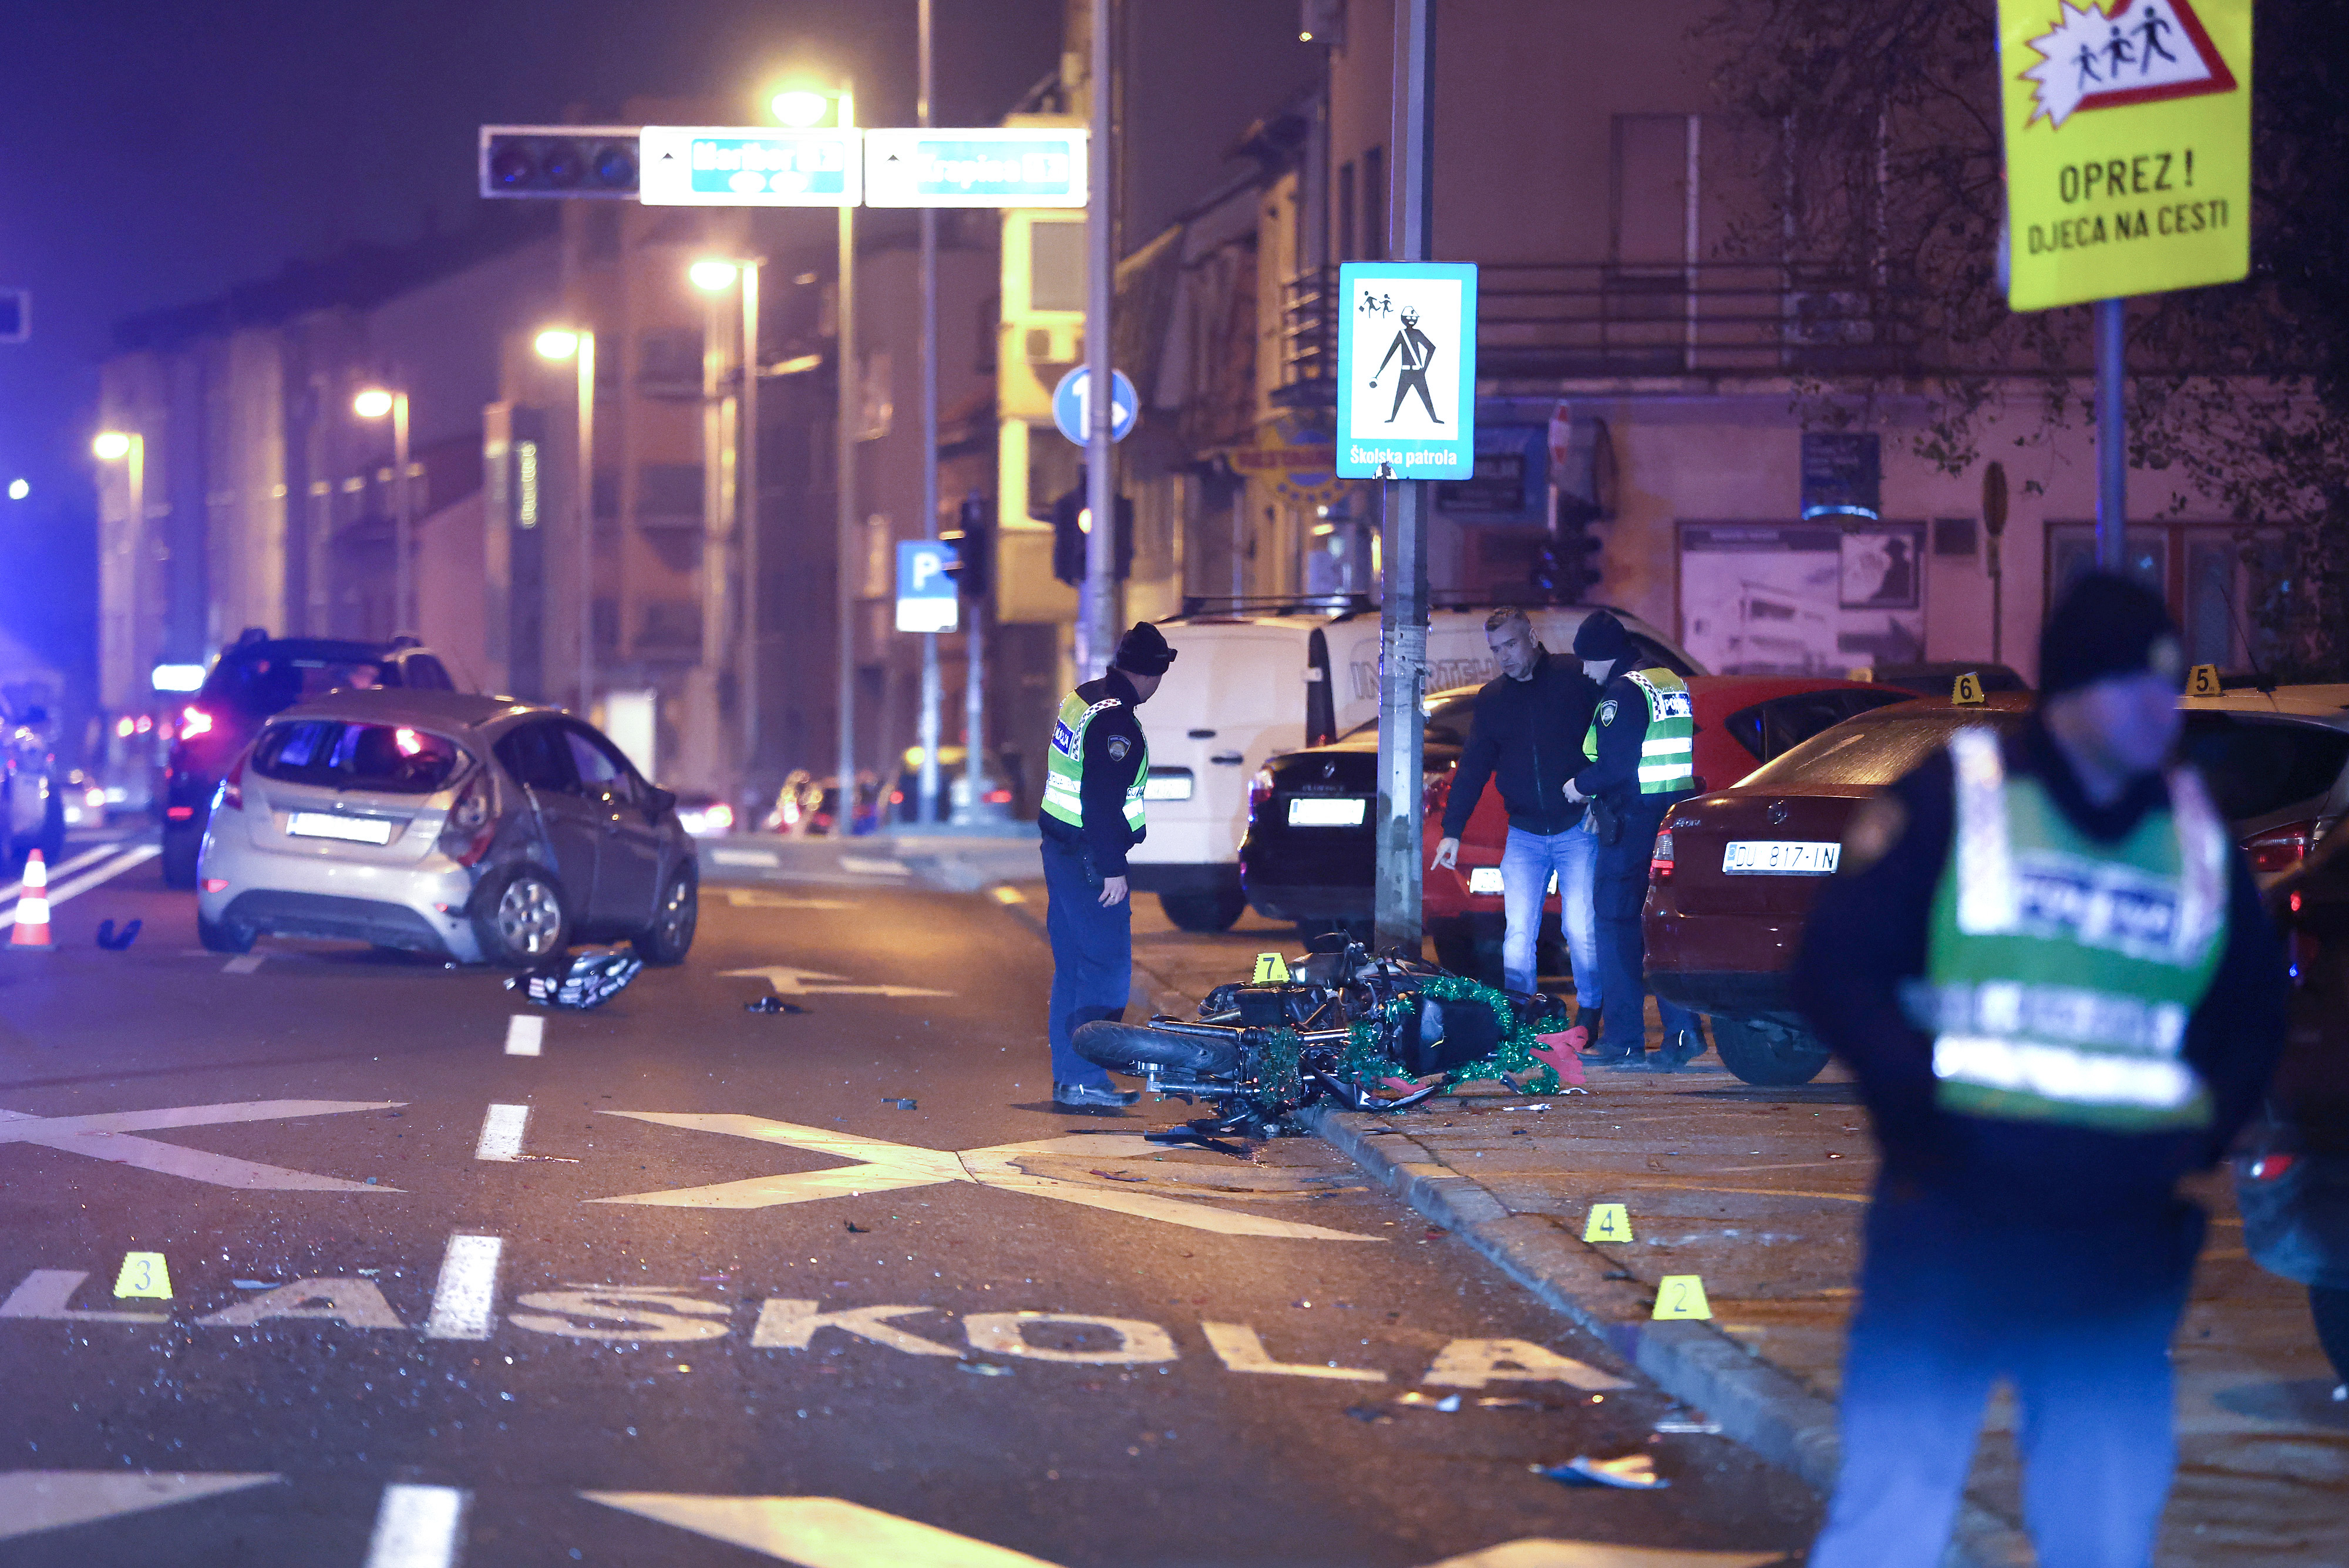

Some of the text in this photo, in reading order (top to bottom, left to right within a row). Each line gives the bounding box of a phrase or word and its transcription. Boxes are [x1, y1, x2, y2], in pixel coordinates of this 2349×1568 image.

[2060, 152, 2172, 204] OPREZ
[2028, 198, 2229, 254] DJECA NA CESTI
[1350, 444, 1403, 464] Školska
[1406, 449, 1458, 468] patrola
[1960, 678, 1972, 700] 6
[2196, 668, 2209, 692] 5
[1736, 846, 1757, 867] DU
[1263, 957, 1275, 980] 7
[1599, 1210, 1614, 1237] 4
[134, 1260, 151, 1291] 3
[1673, 1283, 1687, 1313] 2
